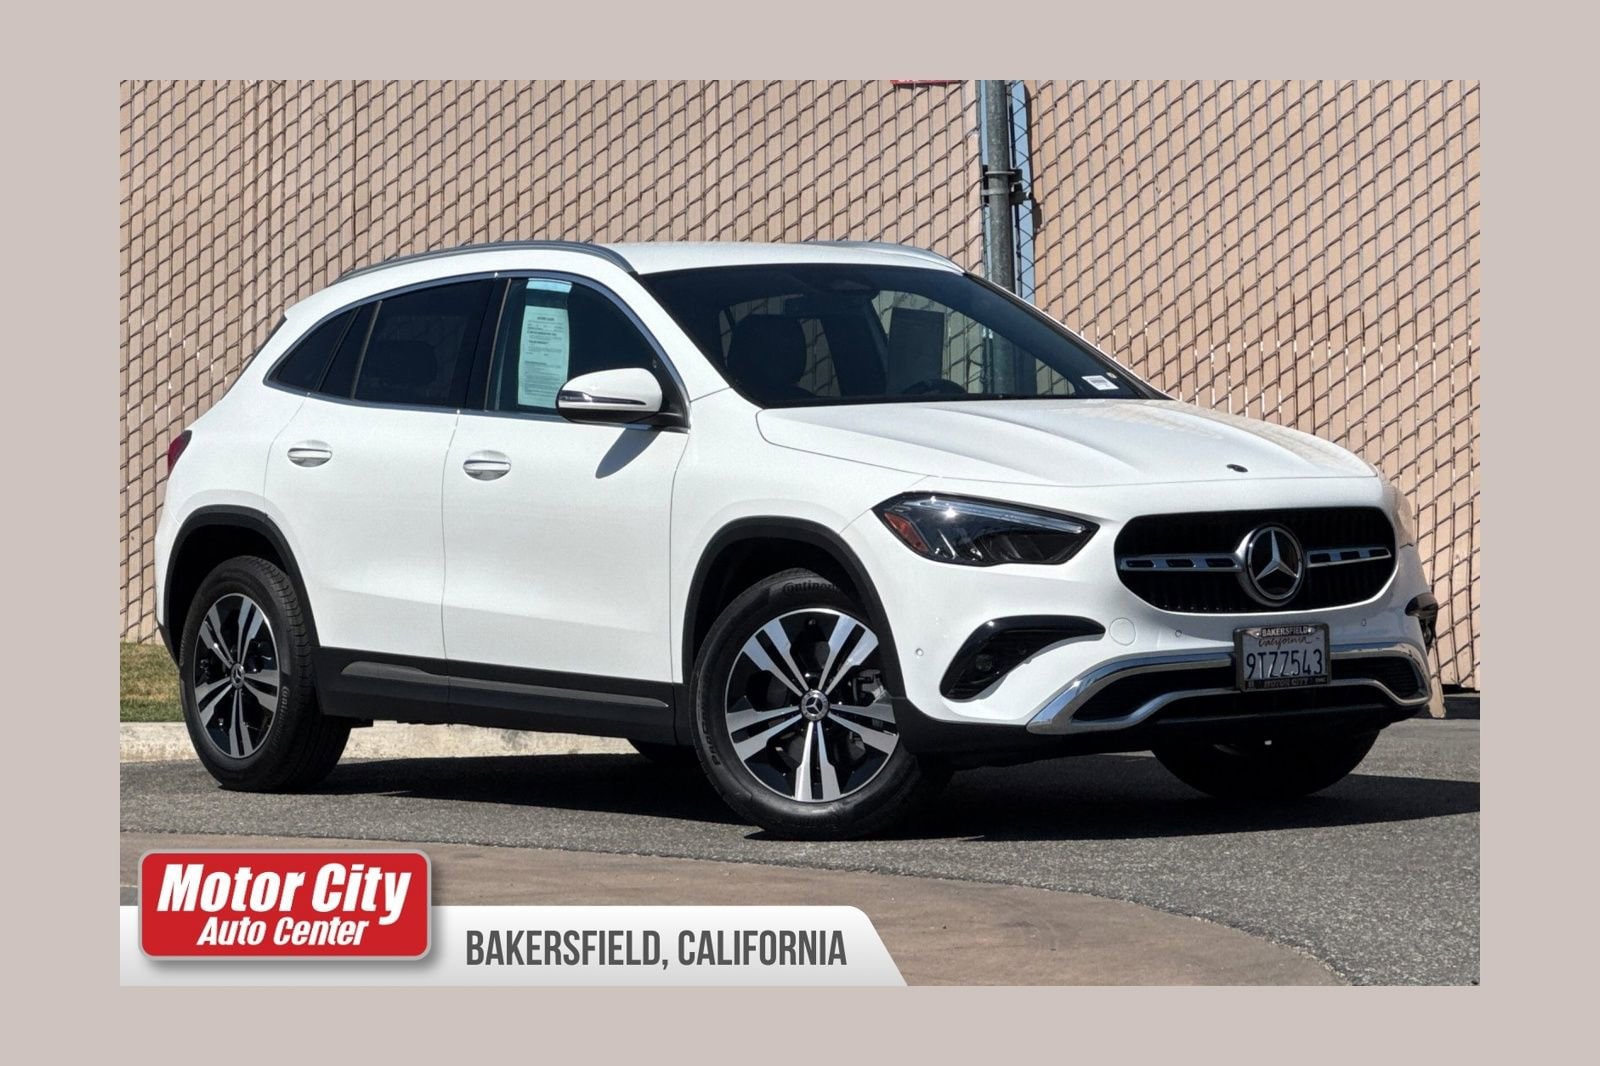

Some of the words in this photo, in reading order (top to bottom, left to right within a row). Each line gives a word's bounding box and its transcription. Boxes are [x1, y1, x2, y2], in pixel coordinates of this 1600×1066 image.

[1261, 626, 1310, 637] BAKERSFIELD
[1258, 636, 1313, 650] California
[1246, 648, 1323, 680] 9TZZ543
[1291, 677, 1309, 687] CITY
